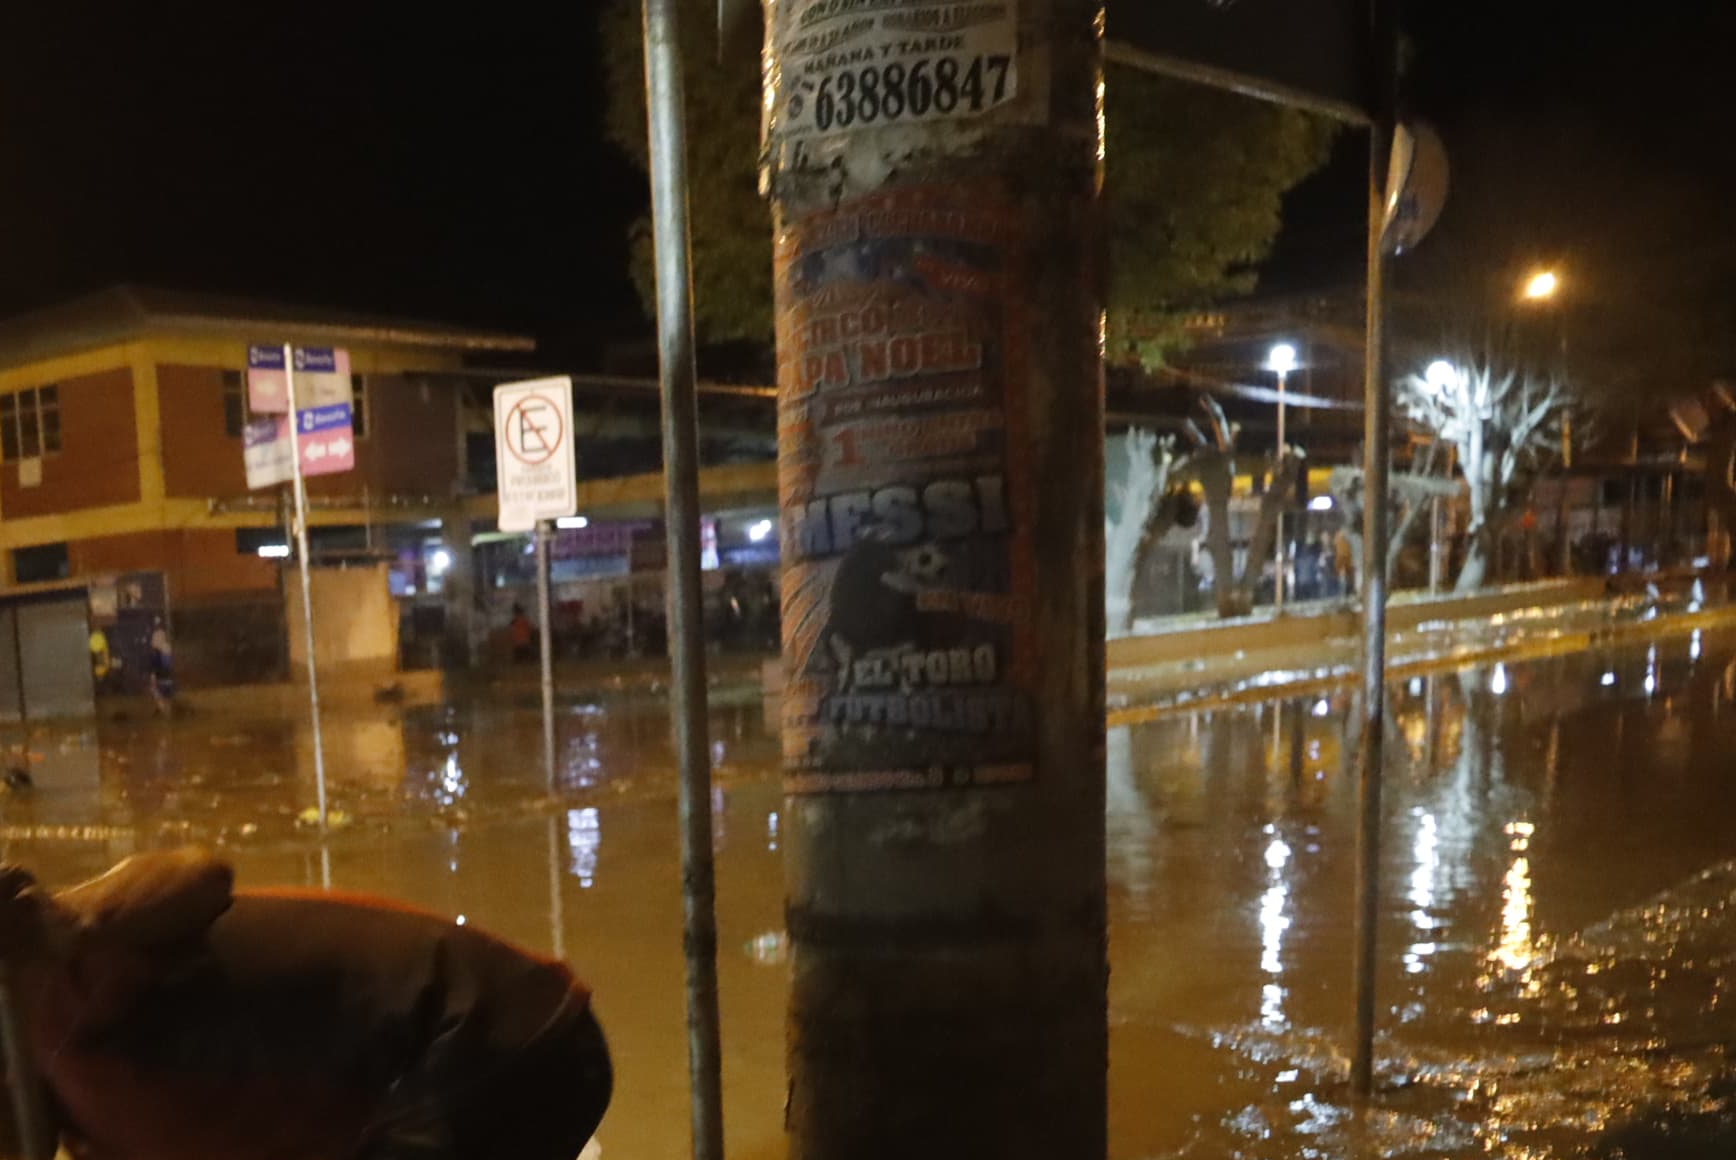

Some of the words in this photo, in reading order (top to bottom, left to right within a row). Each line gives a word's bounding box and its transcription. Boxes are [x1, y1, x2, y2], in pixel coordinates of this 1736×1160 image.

[815, 55, 1011, 131] 63886847
[853, 656, 894, 688] EL
[901, 643, 997, 687] TORO
